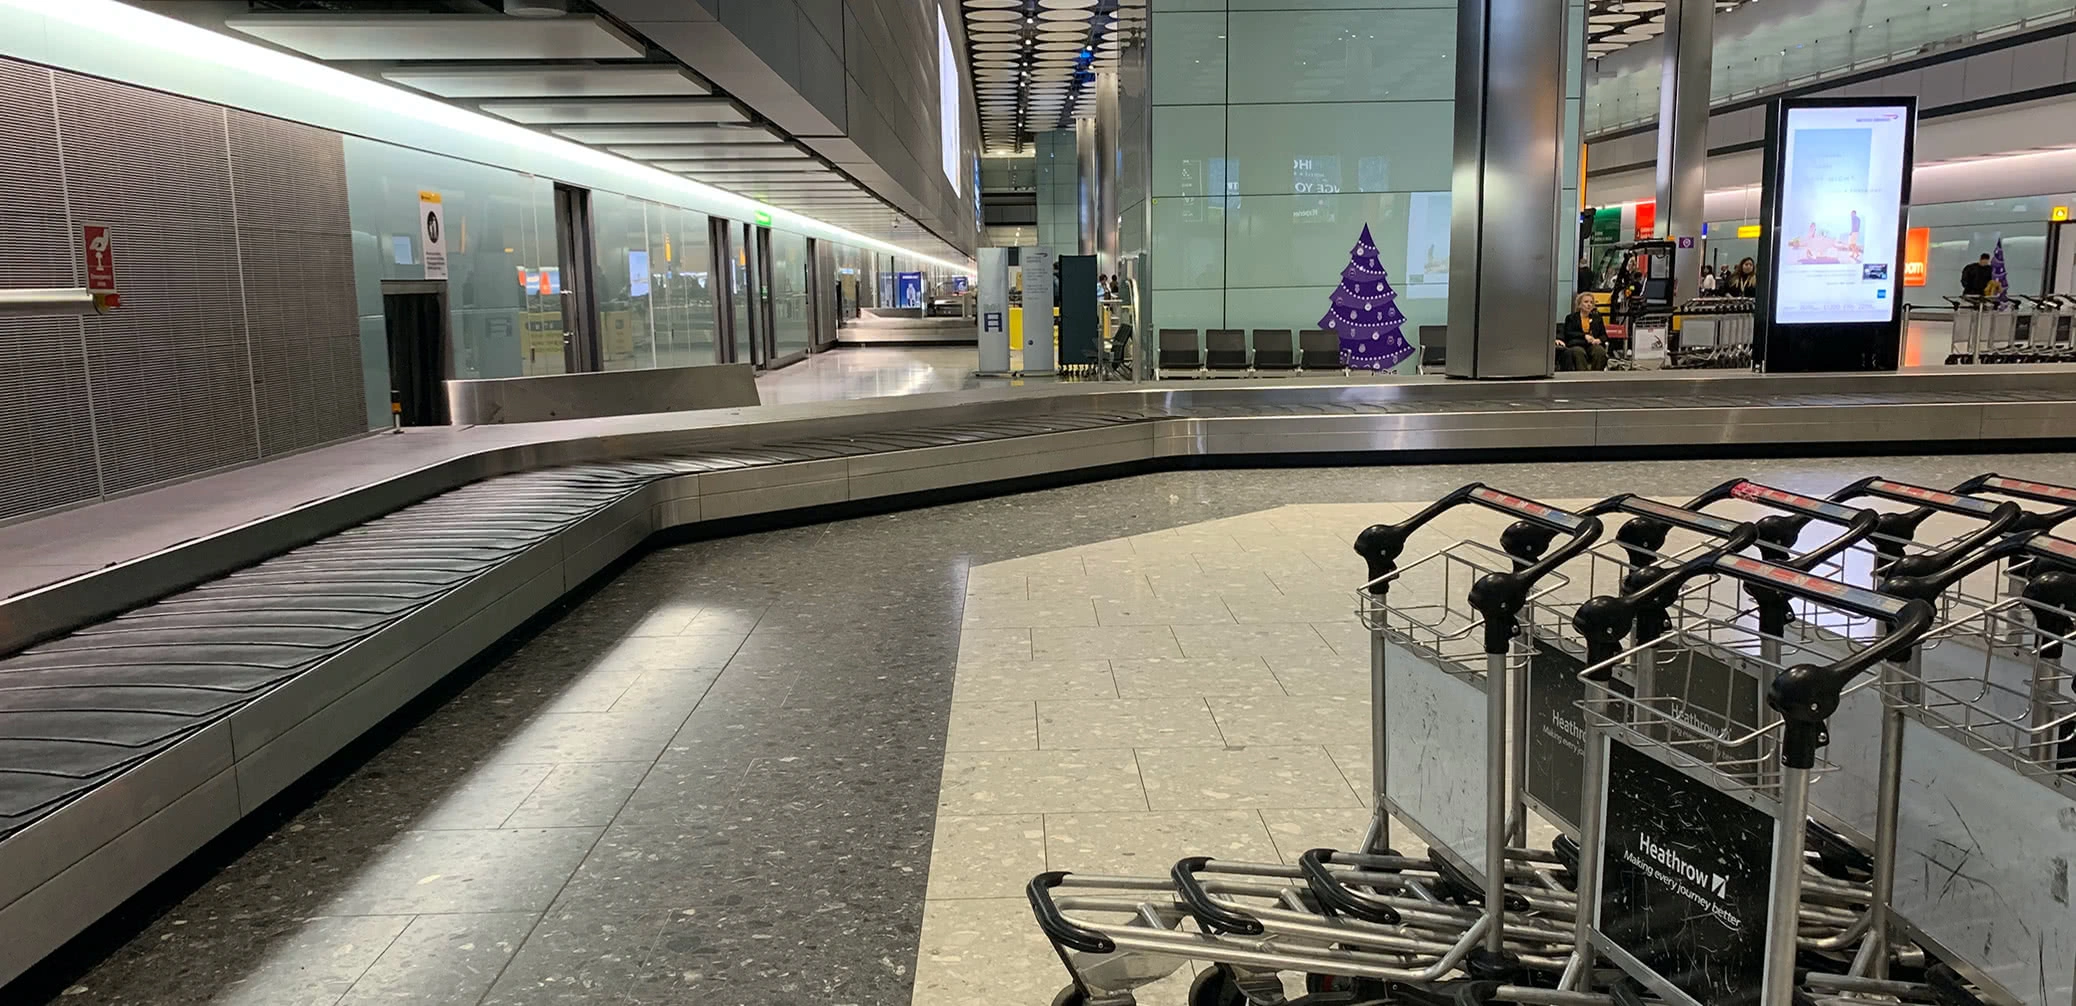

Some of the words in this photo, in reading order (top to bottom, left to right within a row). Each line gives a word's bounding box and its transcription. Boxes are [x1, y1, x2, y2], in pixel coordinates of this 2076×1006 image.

[1552, 709, 1586, 743] Heathro
[1639, 832, 1708, 888] Heathrow
[1623, 850, 1654, 877] Making
[1654, 870, 1677, 891] every
[1676, 883, 1711, 911] journey
[1711, 901, 1741, 927] better
